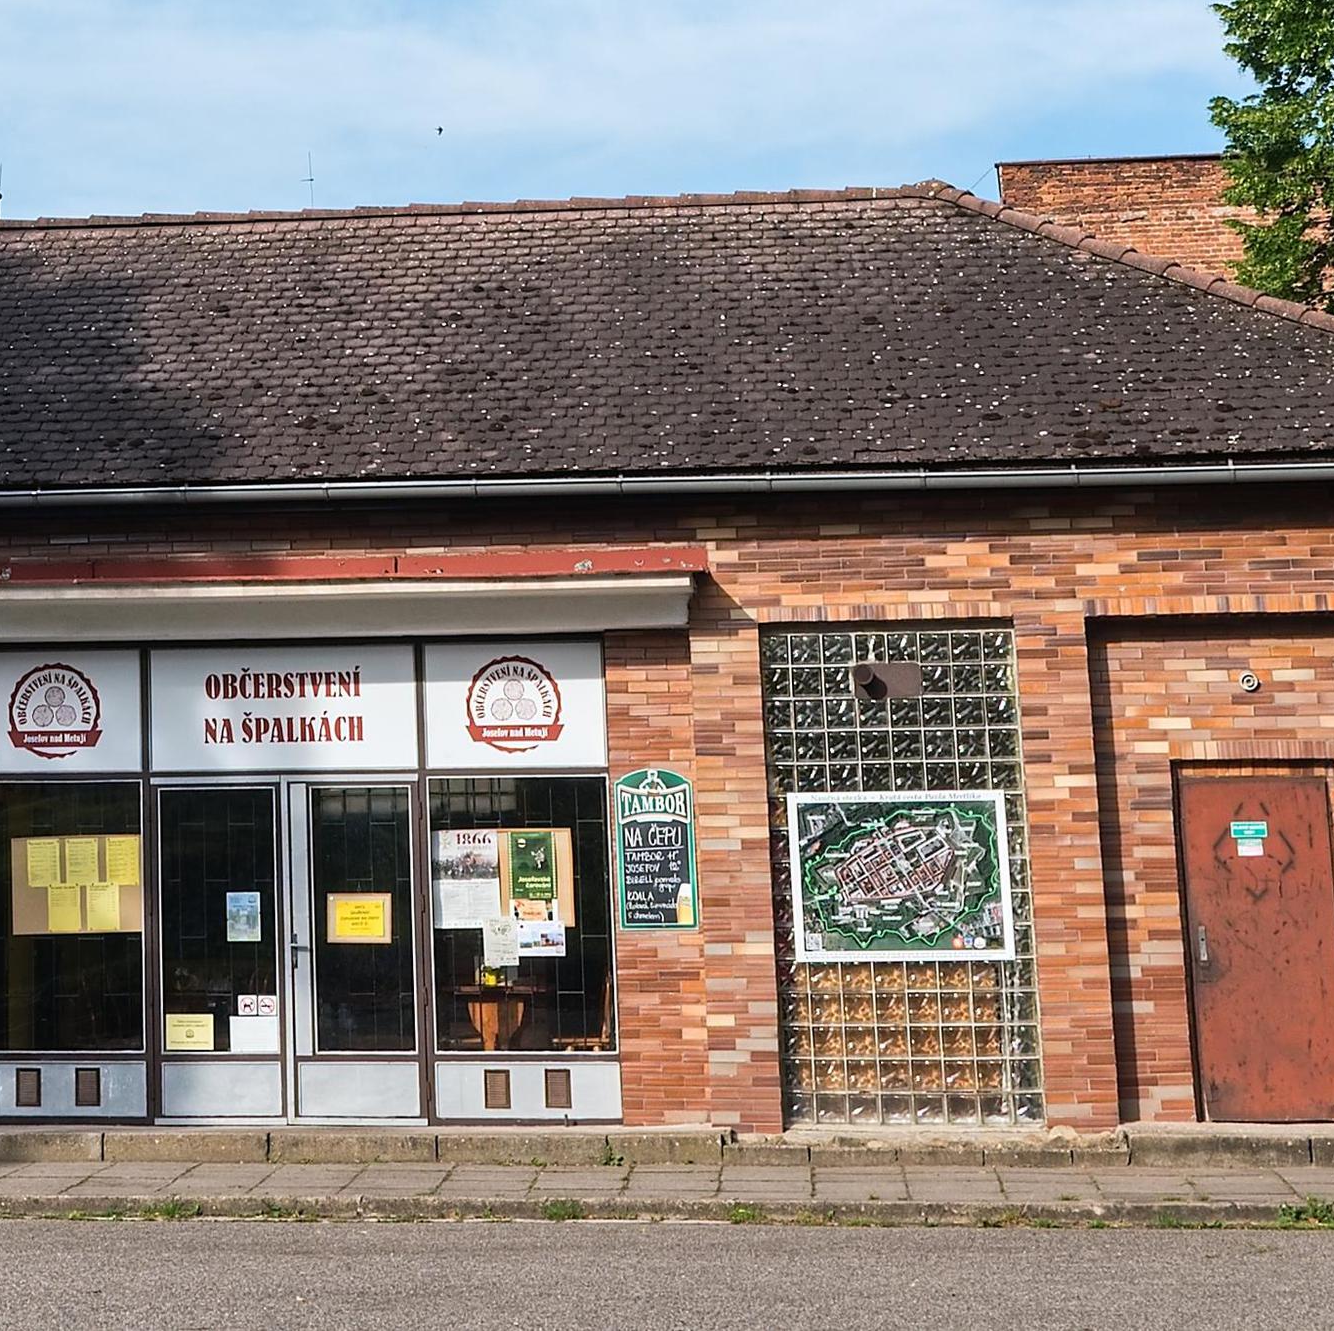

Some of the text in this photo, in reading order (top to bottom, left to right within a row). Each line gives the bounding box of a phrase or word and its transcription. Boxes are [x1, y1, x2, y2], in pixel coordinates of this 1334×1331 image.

[205, 666, 362, 700] OBČERSTVENÍ
[473, 664, 553, 719] OBČERSTVENÍ NA ŠPALKÁCH
[16, 671, 93, 726] OBČERSTVENÍ NA ŠPALKÁCH
[23, 733, 87, 745] Josefov nad Metují
[204, 711, 364, 744] NA ŠPALKÁCH
[482, 727, 509, 738] Josefov
[509, 727, 524, 738] nad
[621, 791, 687, 816] TAMBOR
[456, 832, 492, 845] 1866
[624, 823, 682, 847] NA ČEPU
[625, 850, 665, 862] TAMBOR
[625, 863, 661, 874] JOSEFOV
